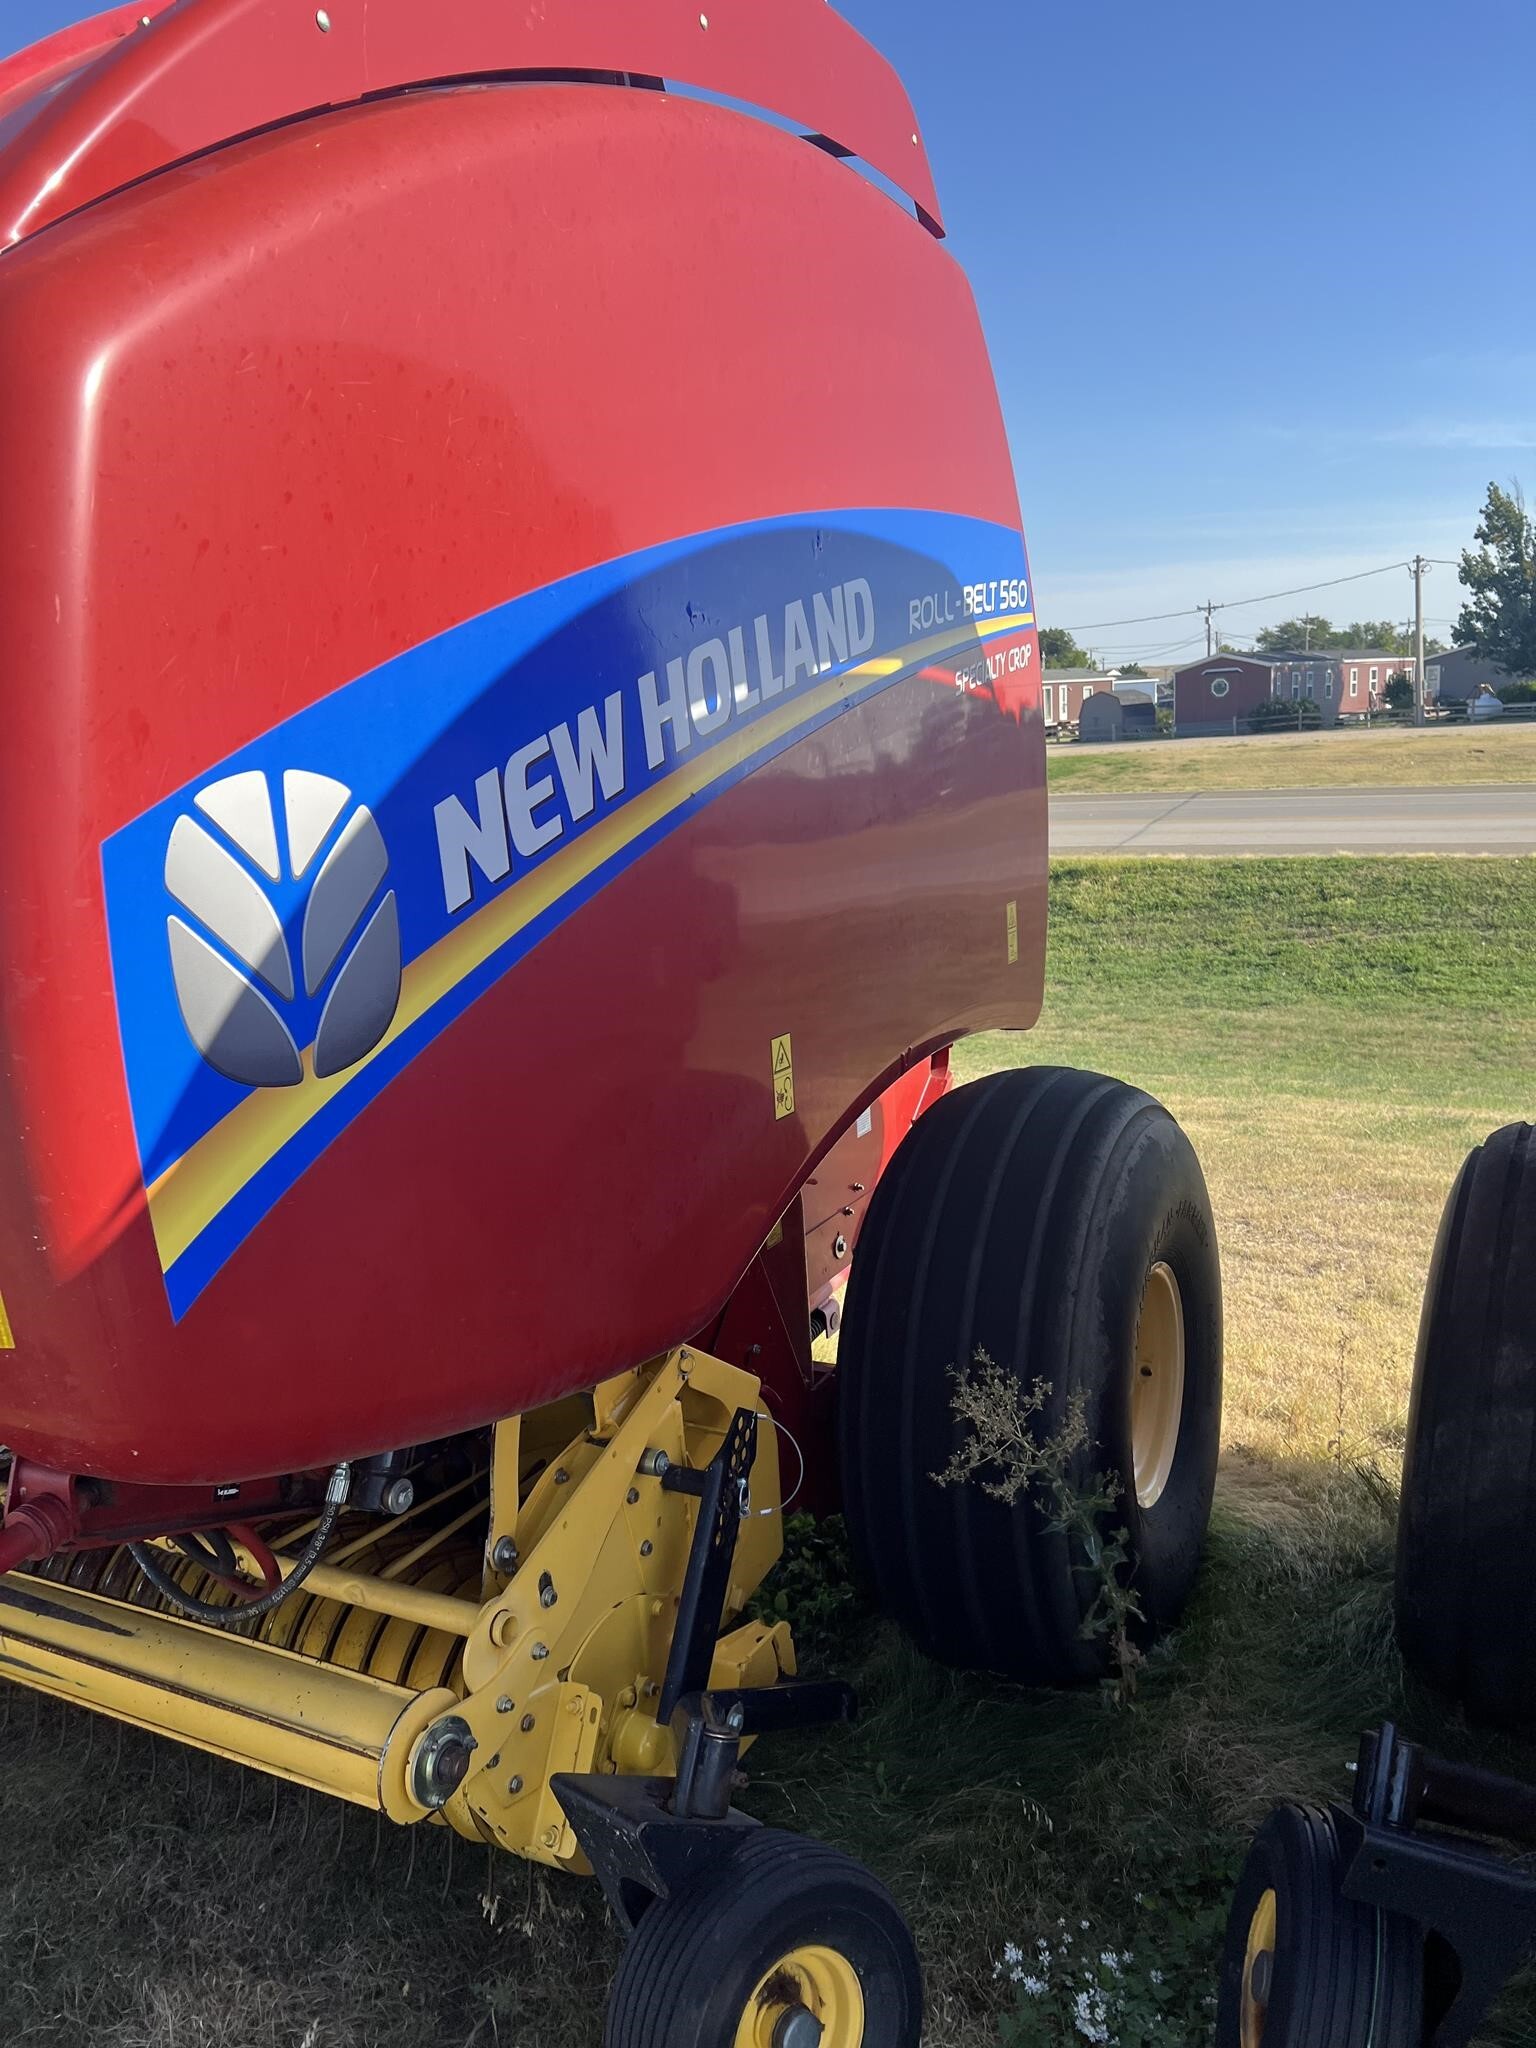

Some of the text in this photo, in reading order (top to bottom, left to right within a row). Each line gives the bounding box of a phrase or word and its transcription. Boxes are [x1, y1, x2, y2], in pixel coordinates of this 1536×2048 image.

[1000, 579, 1028, 610] 560
[955, 643, 1032, 697] SPECIALTY CROP
[433, 577, 875, 915] NEW HOLLAND
